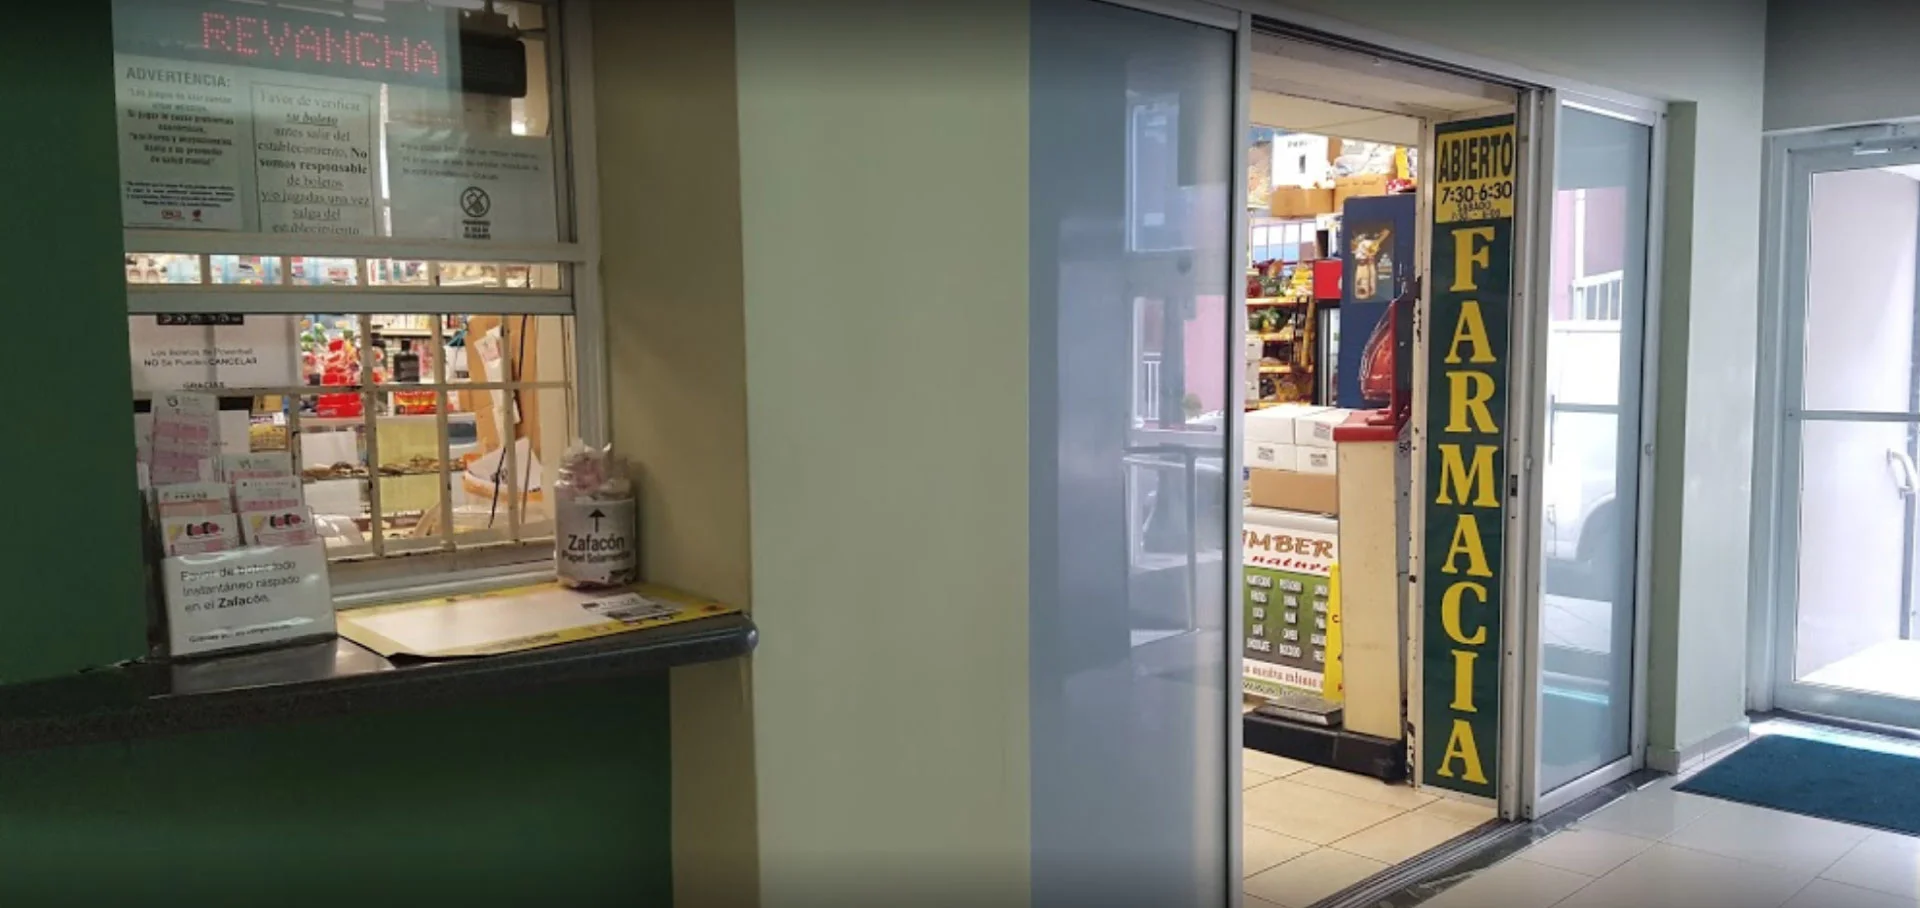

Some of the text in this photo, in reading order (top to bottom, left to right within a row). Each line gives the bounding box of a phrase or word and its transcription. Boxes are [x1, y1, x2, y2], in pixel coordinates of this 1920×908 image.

[202, 11, 439, 75] REVANCHA
[125, 66, 231, 88] ADVERTENCIA:
[260, 88, 361, 112] Favor de verificar
[333, 131, 351, 142] del
[351, 146, 368, 160] No
[1438, 132, 1513, 184] ABIERTO
[259, 158, 369, 175] somos responsable
[286, 173, 301, 187] de
[144, 357, 159, 367] NO
[1436, 226, 1500, 786] FARMACIA
[567, 533, 625, 551] Zafacón
[219, 565, 234, 577] de
[255, 574, 301, 590] raspado
